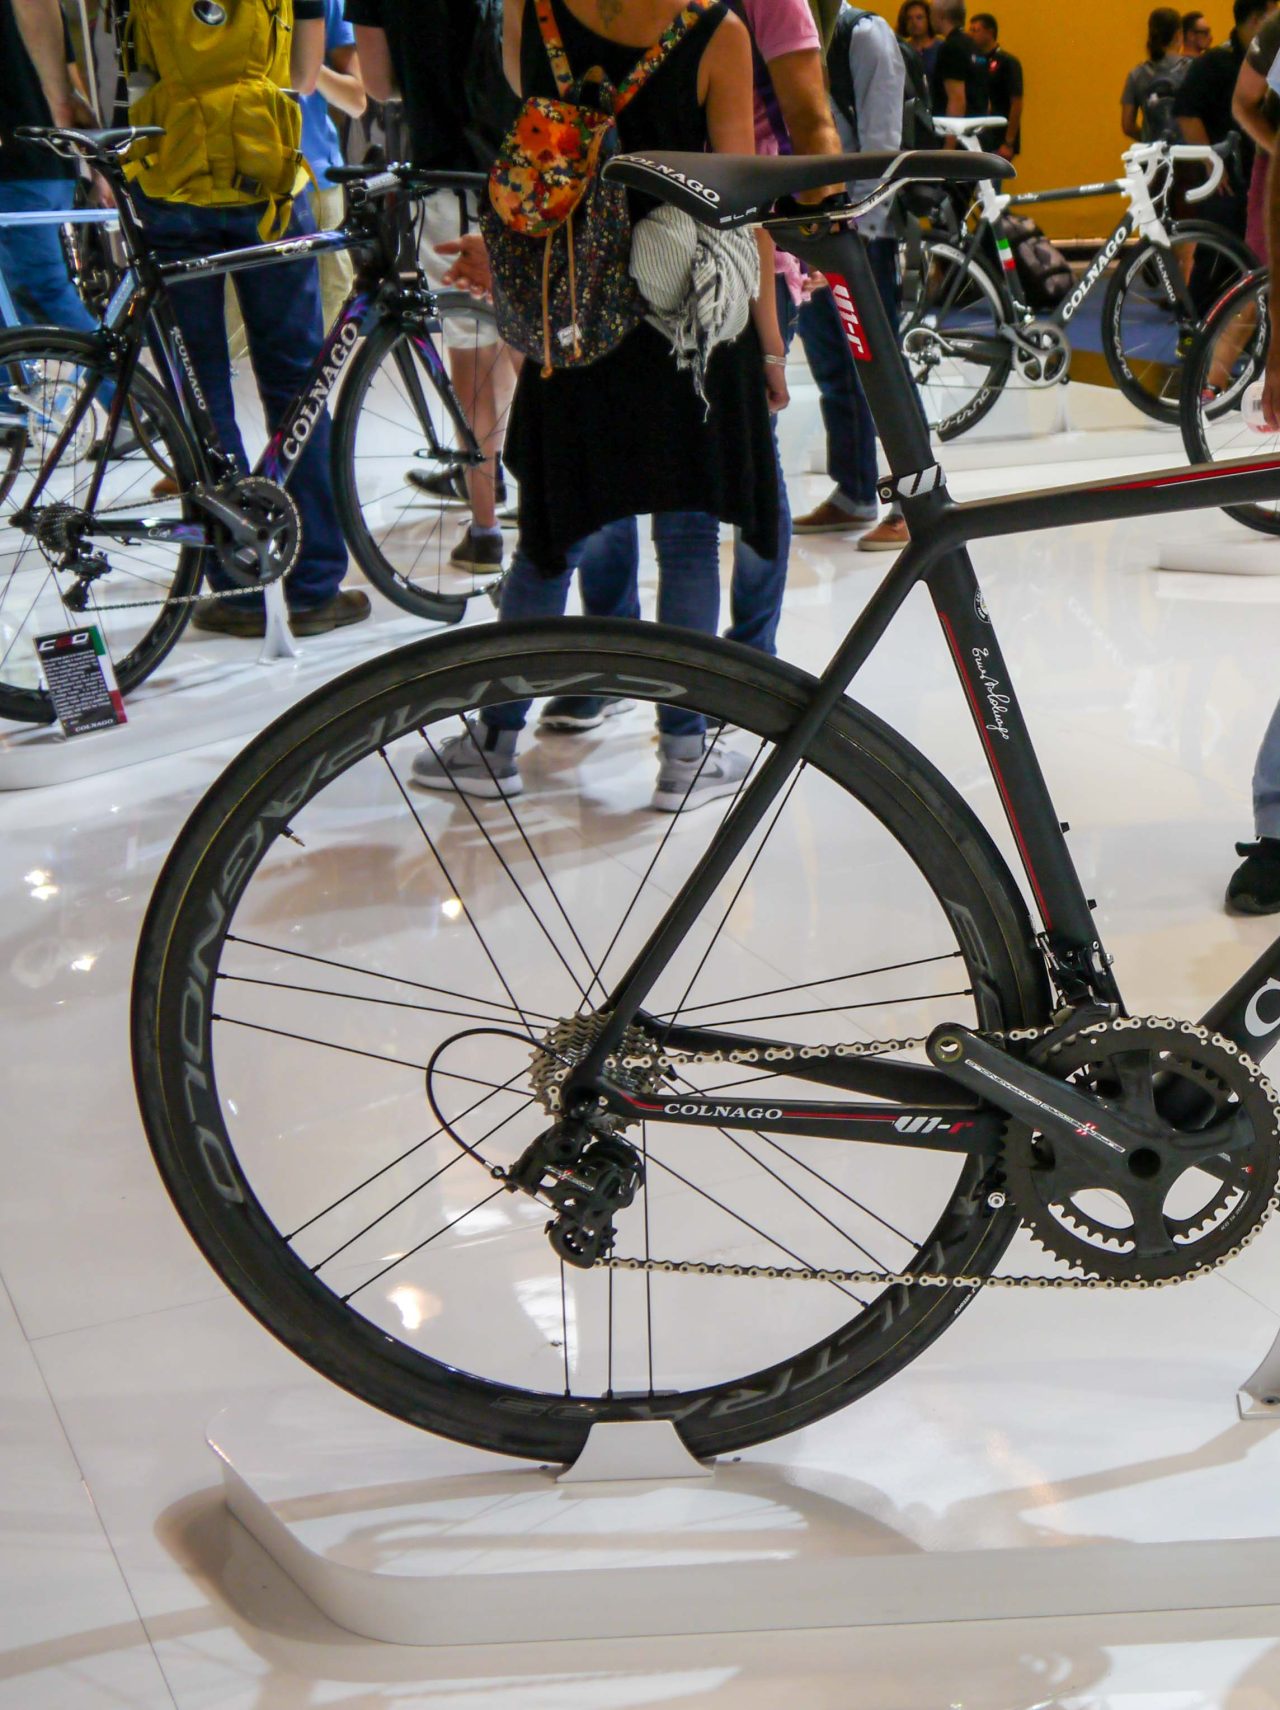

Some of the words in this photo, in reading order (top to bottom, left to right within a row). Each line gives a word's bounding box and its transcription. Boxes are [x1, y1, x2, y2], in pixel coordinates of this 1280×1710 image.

[719, 206, 758, 224] SLR
[1062, 226, 1128, 321] COLNAGO
[174, 333, 206, 411] COLNAGO
[282, 322, 358, 461] COLNAGO
[663, 1103, 783, 1120] COLNAGO
